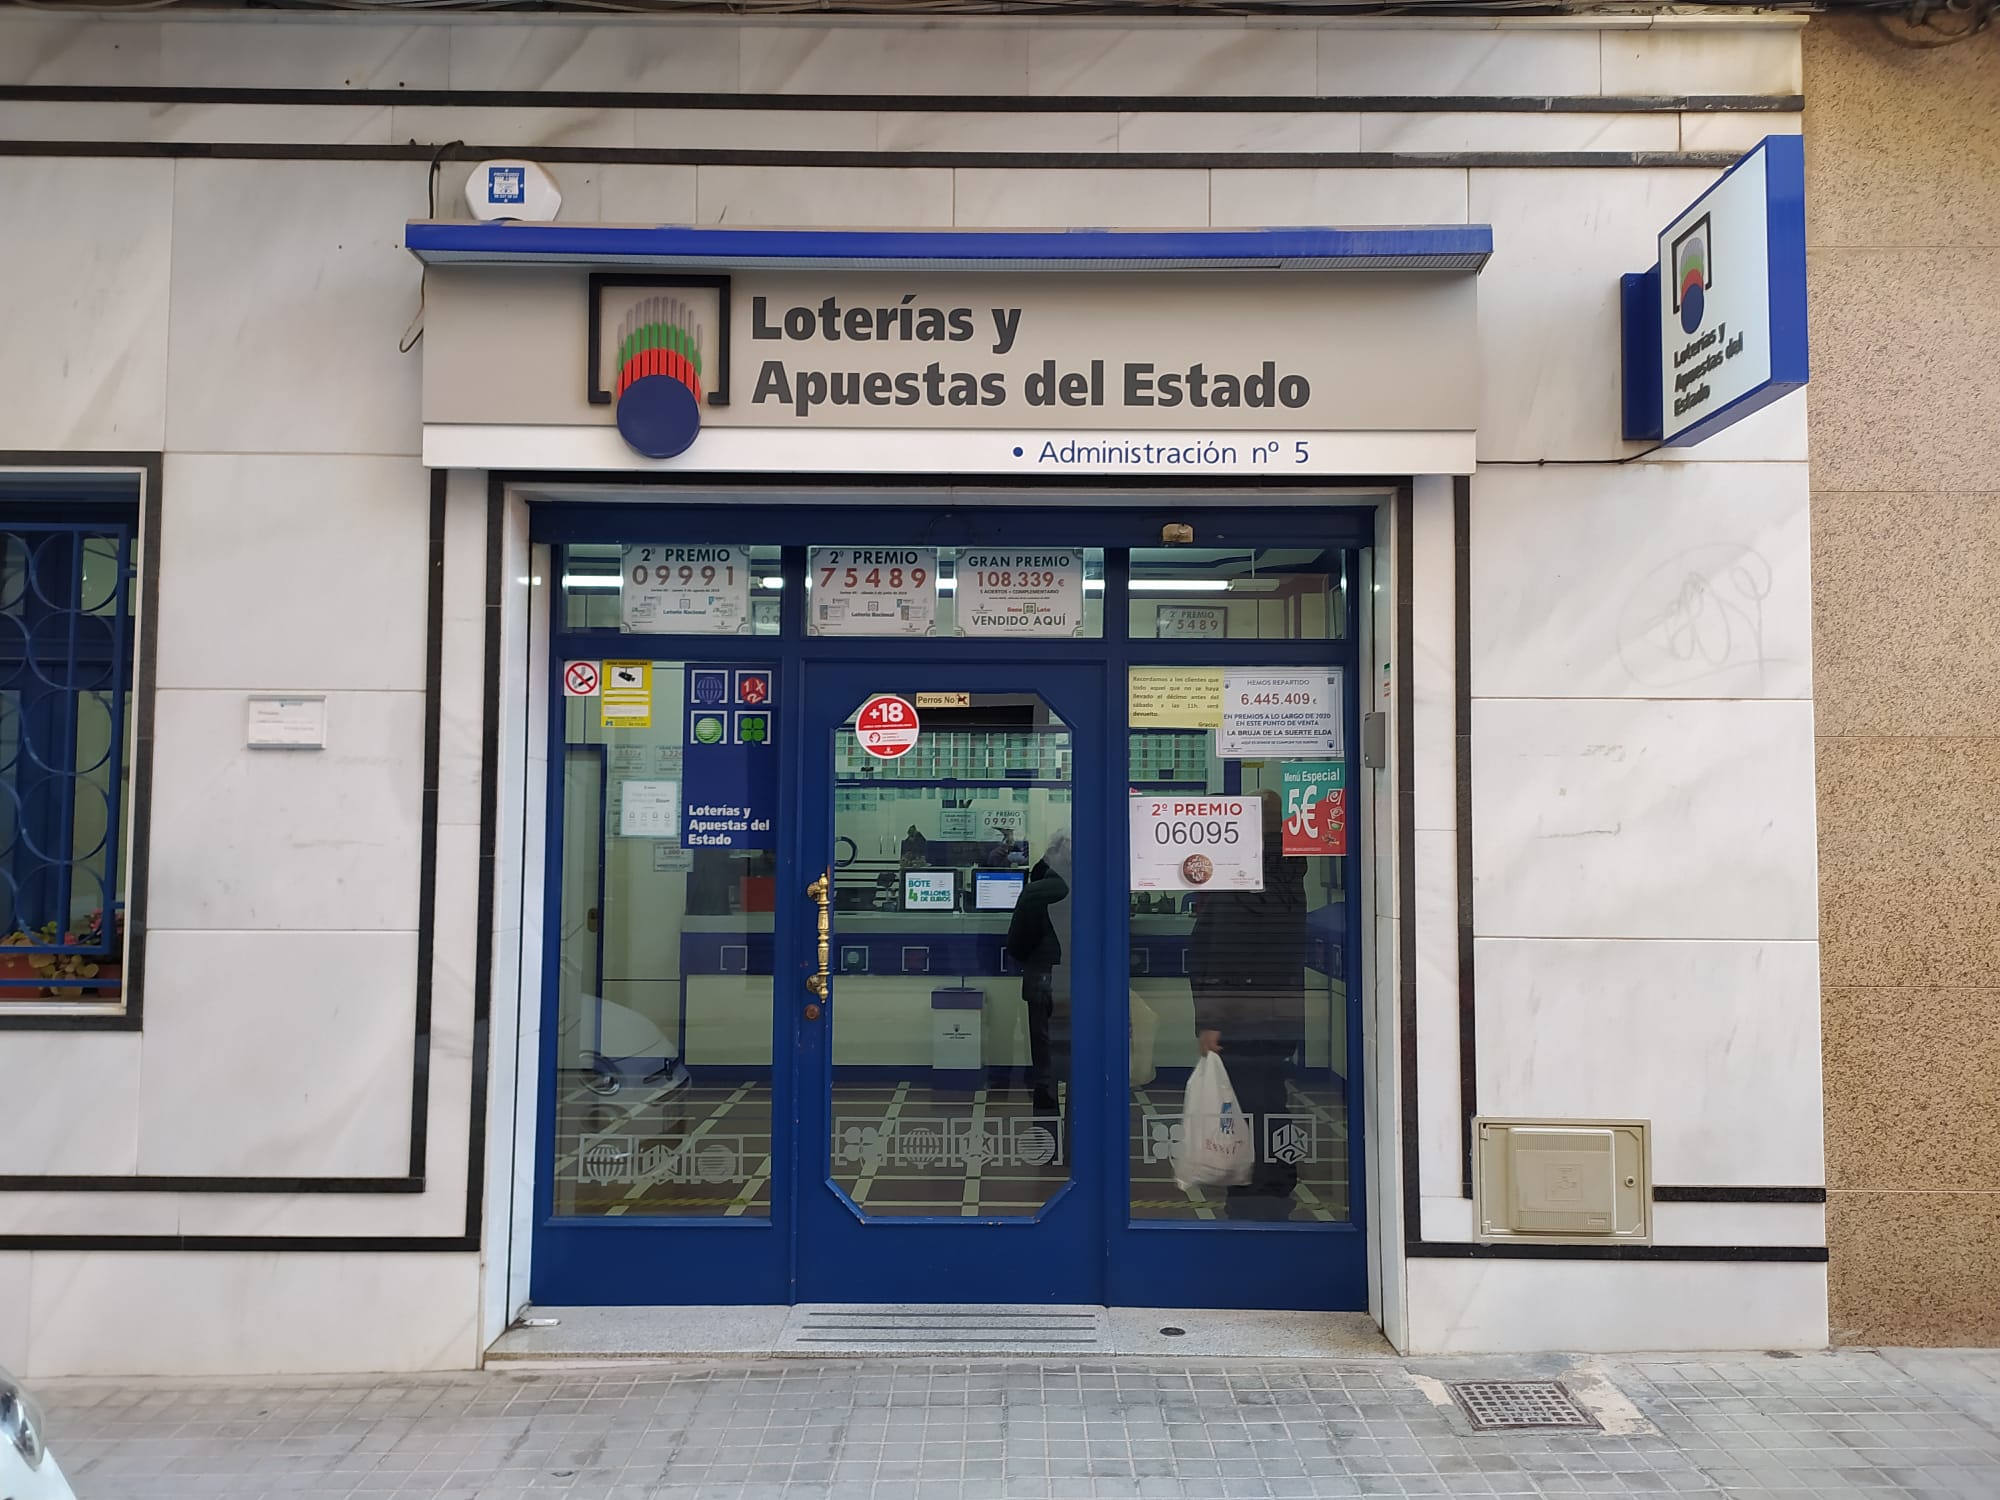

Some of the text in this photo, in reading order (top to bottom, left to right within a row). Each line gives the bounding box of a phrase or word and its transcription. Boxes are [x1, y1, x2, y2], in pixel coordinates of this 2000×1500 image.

[752, 294, 1022, 355] Loterías y
[1673, 322, 1726, 368] Loterías y
[1674, 331, 1744, 393] Apuestas del
[751, 359, 1311, 417] Apuestas del Estado
[1673, 383, 1711, 417] Estado
[1038, 440, 1309, 465] Administración nº 5
[664, 548, 731, 562] PREMIO
[852, 551, 918, 565] PREMIO
[968, 555, 1070, 568] GRAN PREMIO
[632, 564, 734, 586] 09991
[820, 567, 927, 589] 75489
[976, 570, 1055, 588] 108.339
[971, 613, 1066, 626] VENDIDO AQUÍ
[1181, 611, 1215, 619] PREMIO
[1164, 619, 1219, 631] 75489
[917, 695, 955, 704] Perros No
[1240, 692, 1310, 706] 6.445.409
[868, 702, 904, 723] +18
[1284, 767, 1340, 784] Menú Especial
[688, 804, 752, 819] Loterías y
[1151, 803, 1243, 817] 2º PREMIO
[1287, 784, 1319, 839] 5€
[688, 819, 747, 833] Apuestas
[750, 818, 770, 831] del
[1155, 821, 1239, 845] 06095
[687, 833, 732, 846] Estado
[908, 879, 932, 888] BOTE
